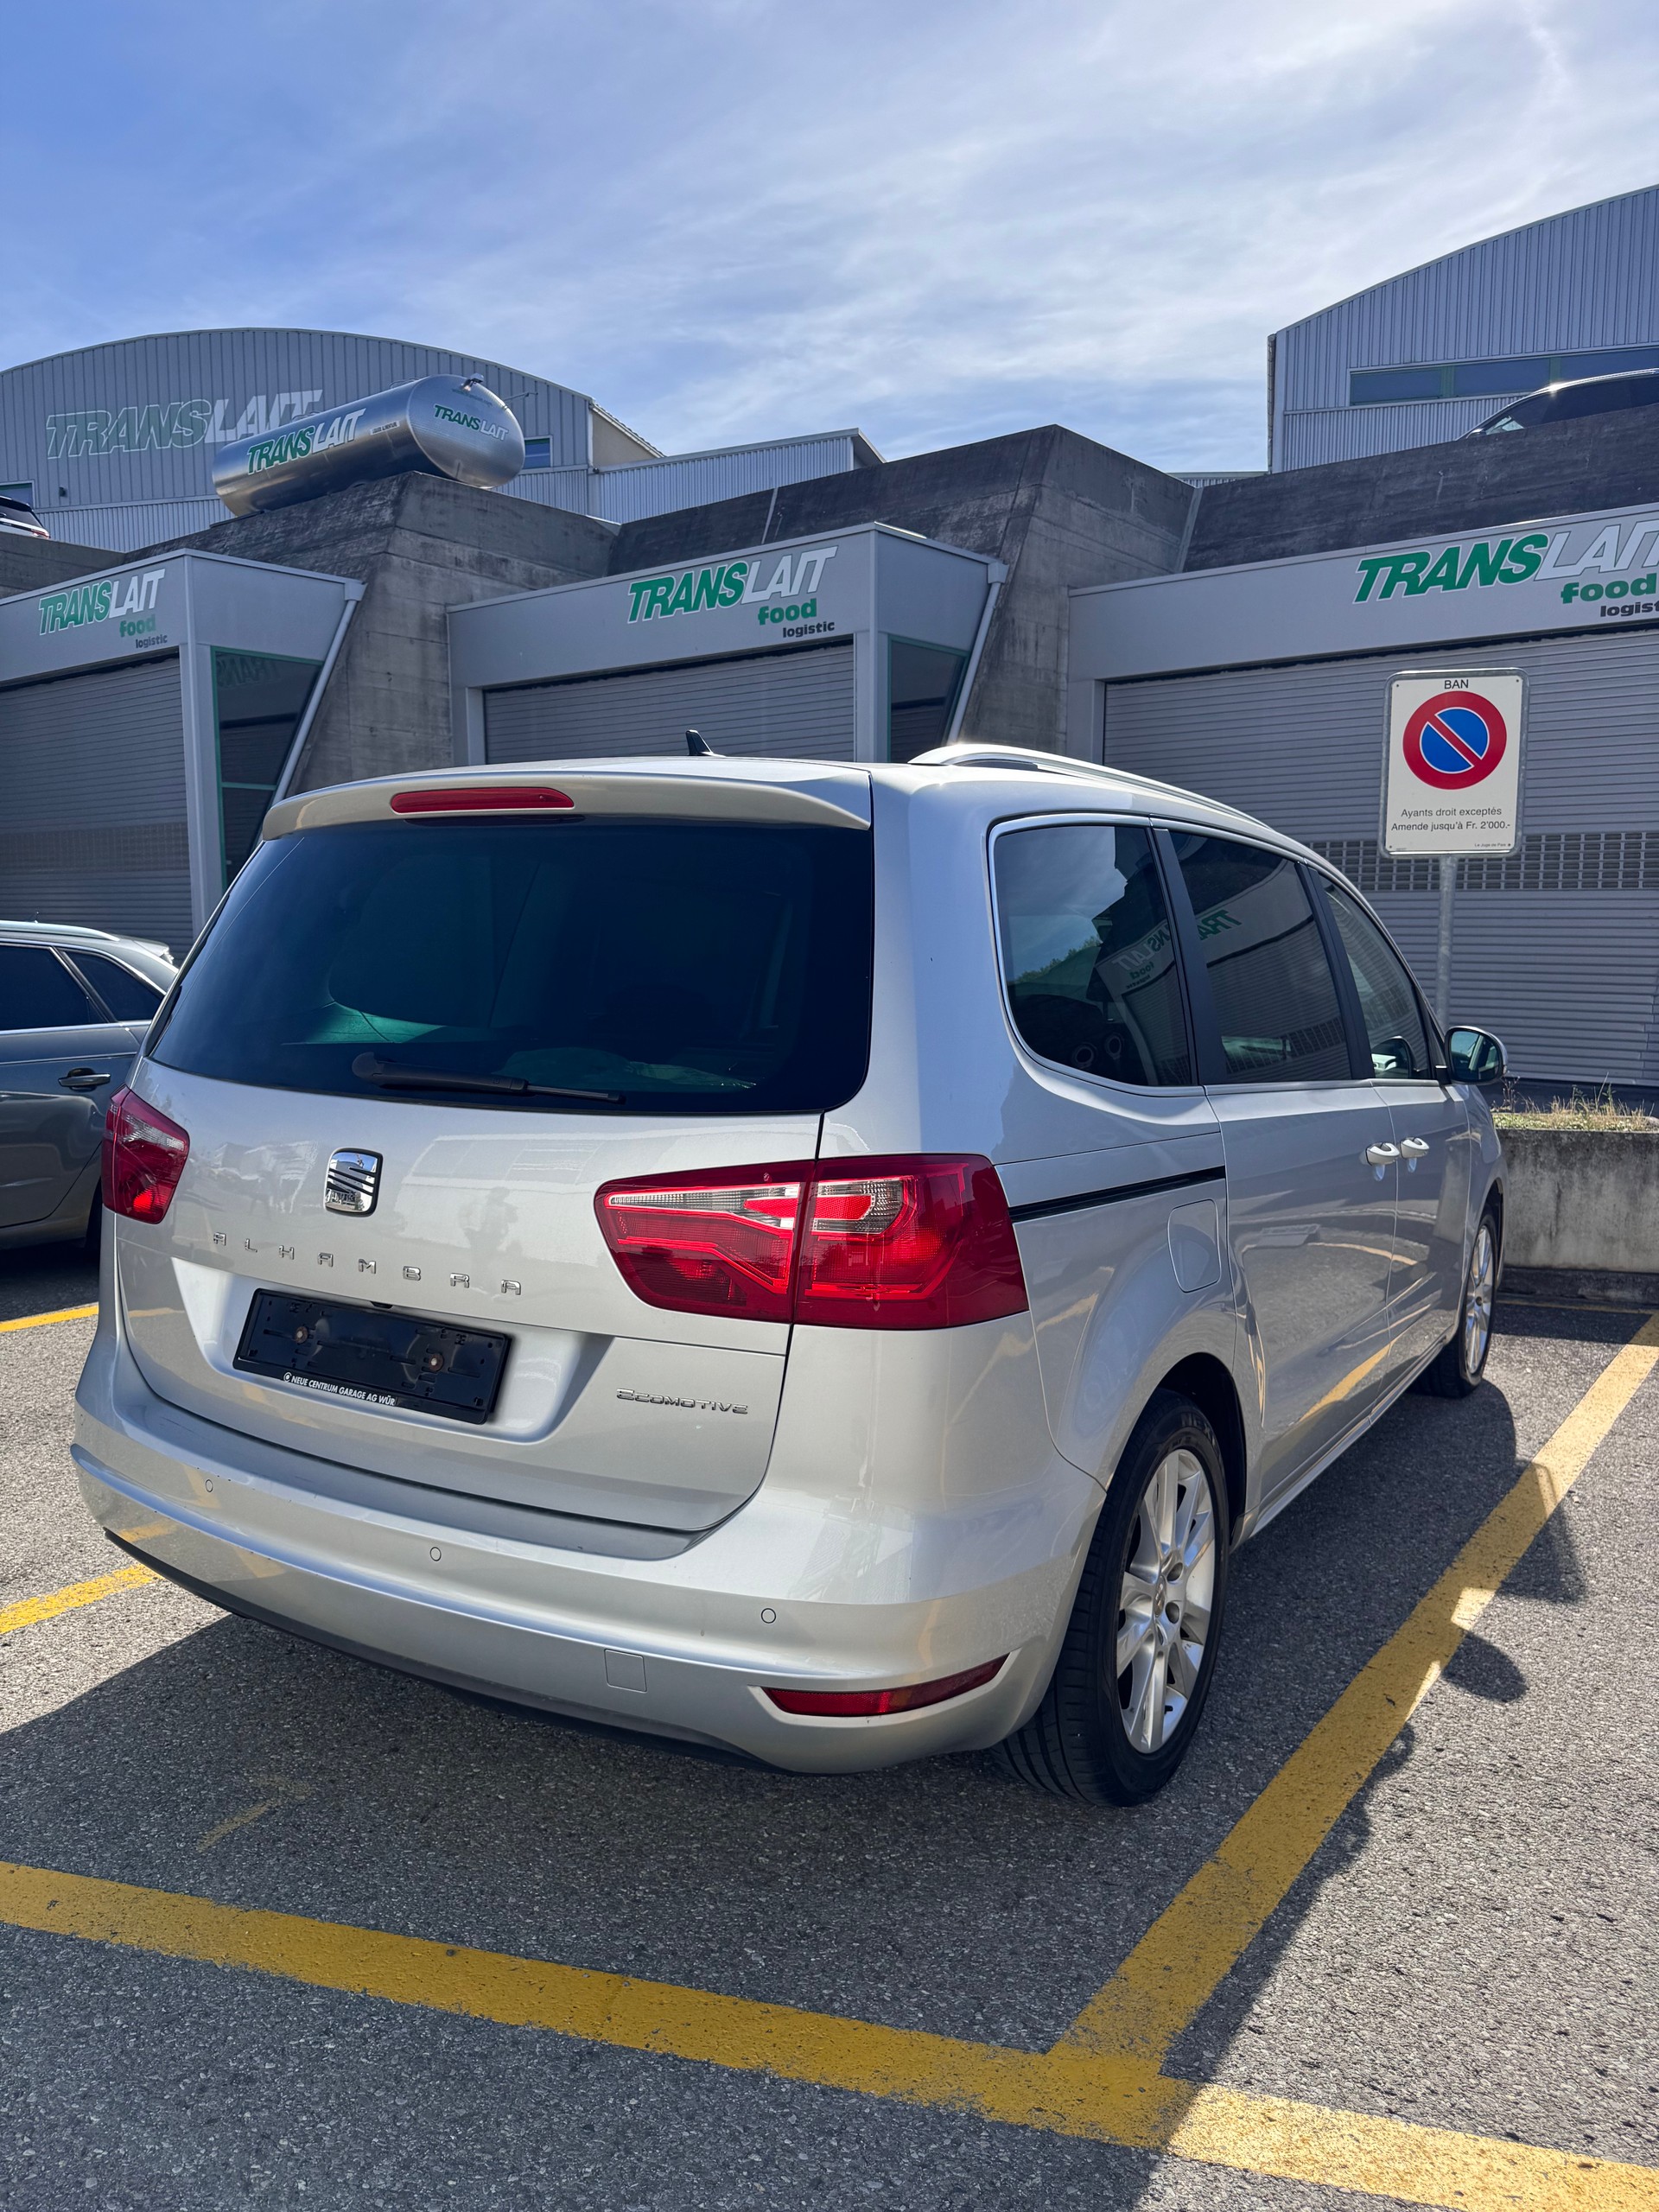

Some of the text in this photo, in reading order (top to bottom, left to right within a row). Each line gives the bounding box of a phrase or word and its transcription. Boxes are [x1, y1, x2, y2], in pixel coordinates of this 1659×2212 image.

[434, 404, 509, 442] TRANSLAIT
[247, 408, 367, 475] TRANSLAIT
[626, 545, 839, 624] TRANSLAIT
[1560, 572, 1657, 605] food
[38, 569, 166, 636] TRANSLAIT
[758, 598, 817, 626] food
[119, 613, 156, 638] food
[782, 620, 836, 639] logistic
[136, 634, 168, 649] logistic
[1444, 679, 1469, 690] BAN
[1401, 806, 1502, 818] Ayants droit exceptés
[1391, 821, 1510, 832] Amende jusqu'à Fr. 2'000.-
[213, 1231, 522, 1296] ALHAMBRA
[291, 1376, 308, 1386] NEUE
[308, 1380, 338, 1393] CENTRUM
[339, 1387, 365, 1400] GARAGE
[366, 1393, 378, 1402] AG
